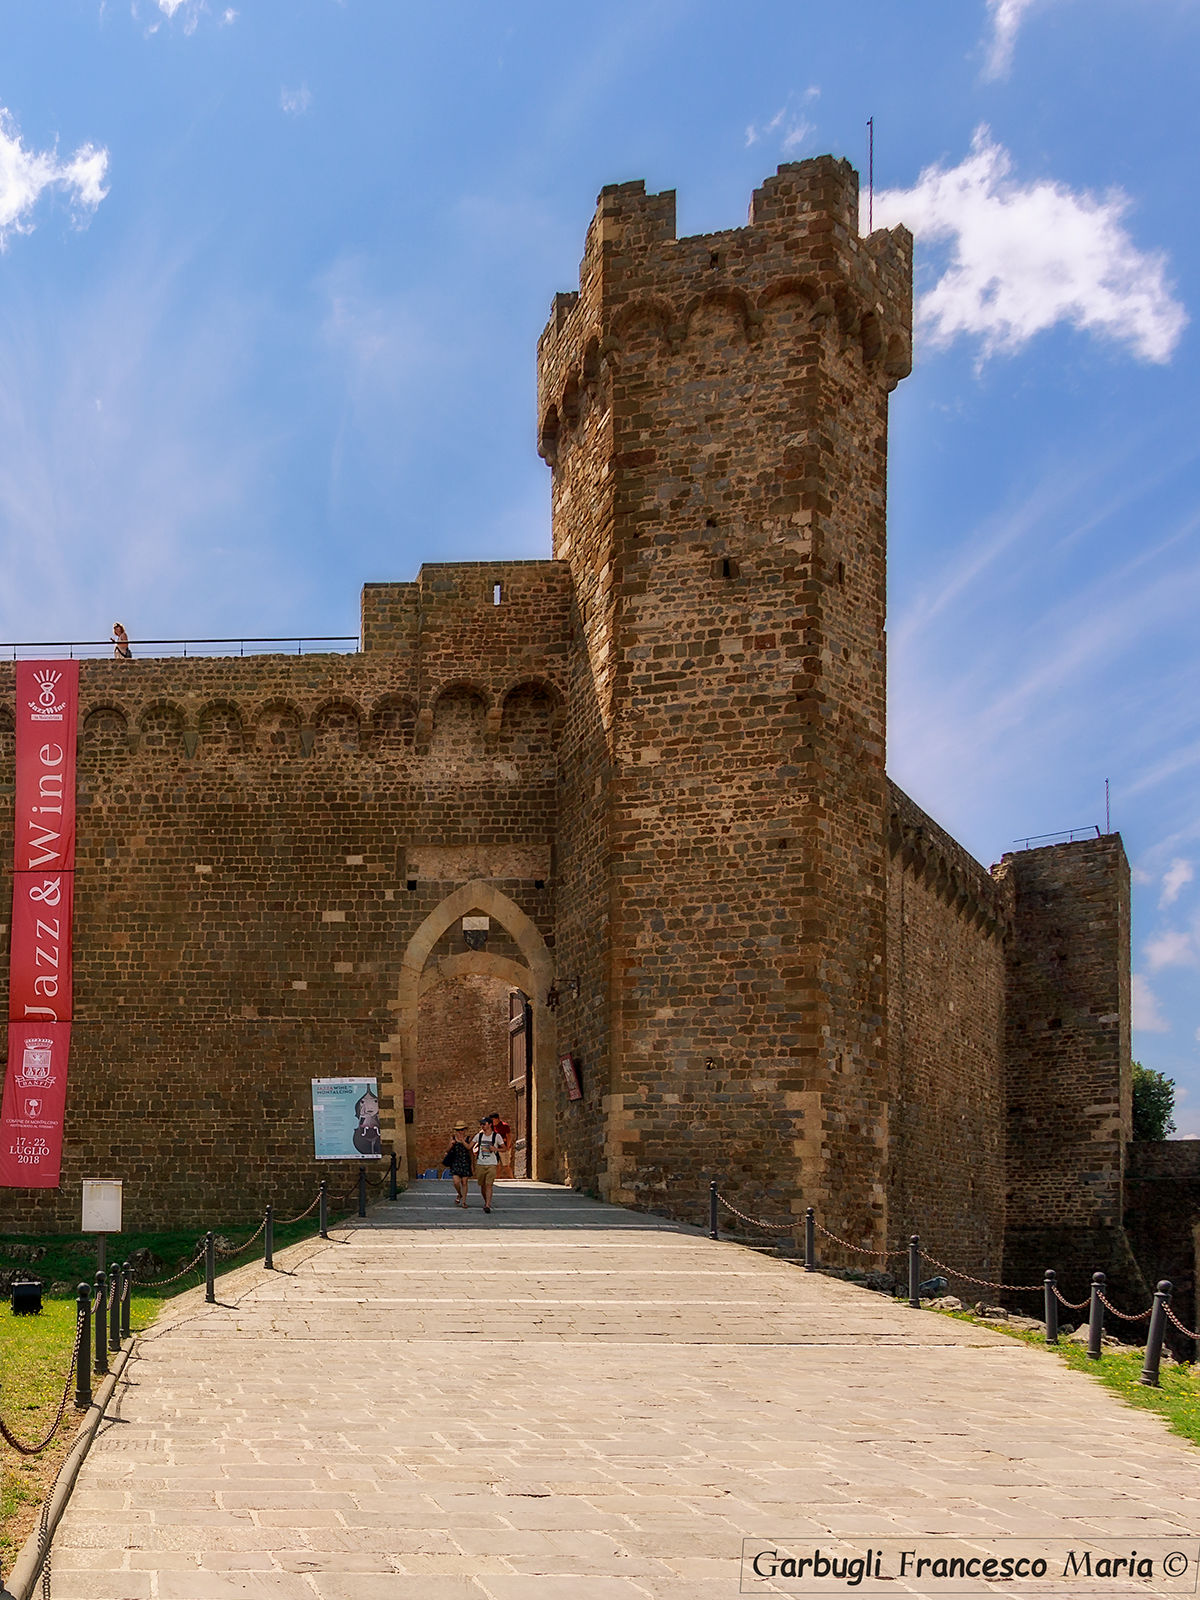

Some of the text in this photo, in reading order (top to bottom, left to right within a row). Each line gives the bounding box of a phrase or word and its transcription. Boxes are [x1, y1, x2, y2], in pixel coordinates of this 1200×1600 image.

[28, 743, 64, 869] Wine
[29, 876, 61, 907] &
[24, 918, 60, 1024] Jazz
[9, 1146, 50, 1156] LUGLIO
[16, 1137, 26, 1146] 17
[34, 1138, 46, 1147] 22
[17, 1156, 40, 1164] 2018
